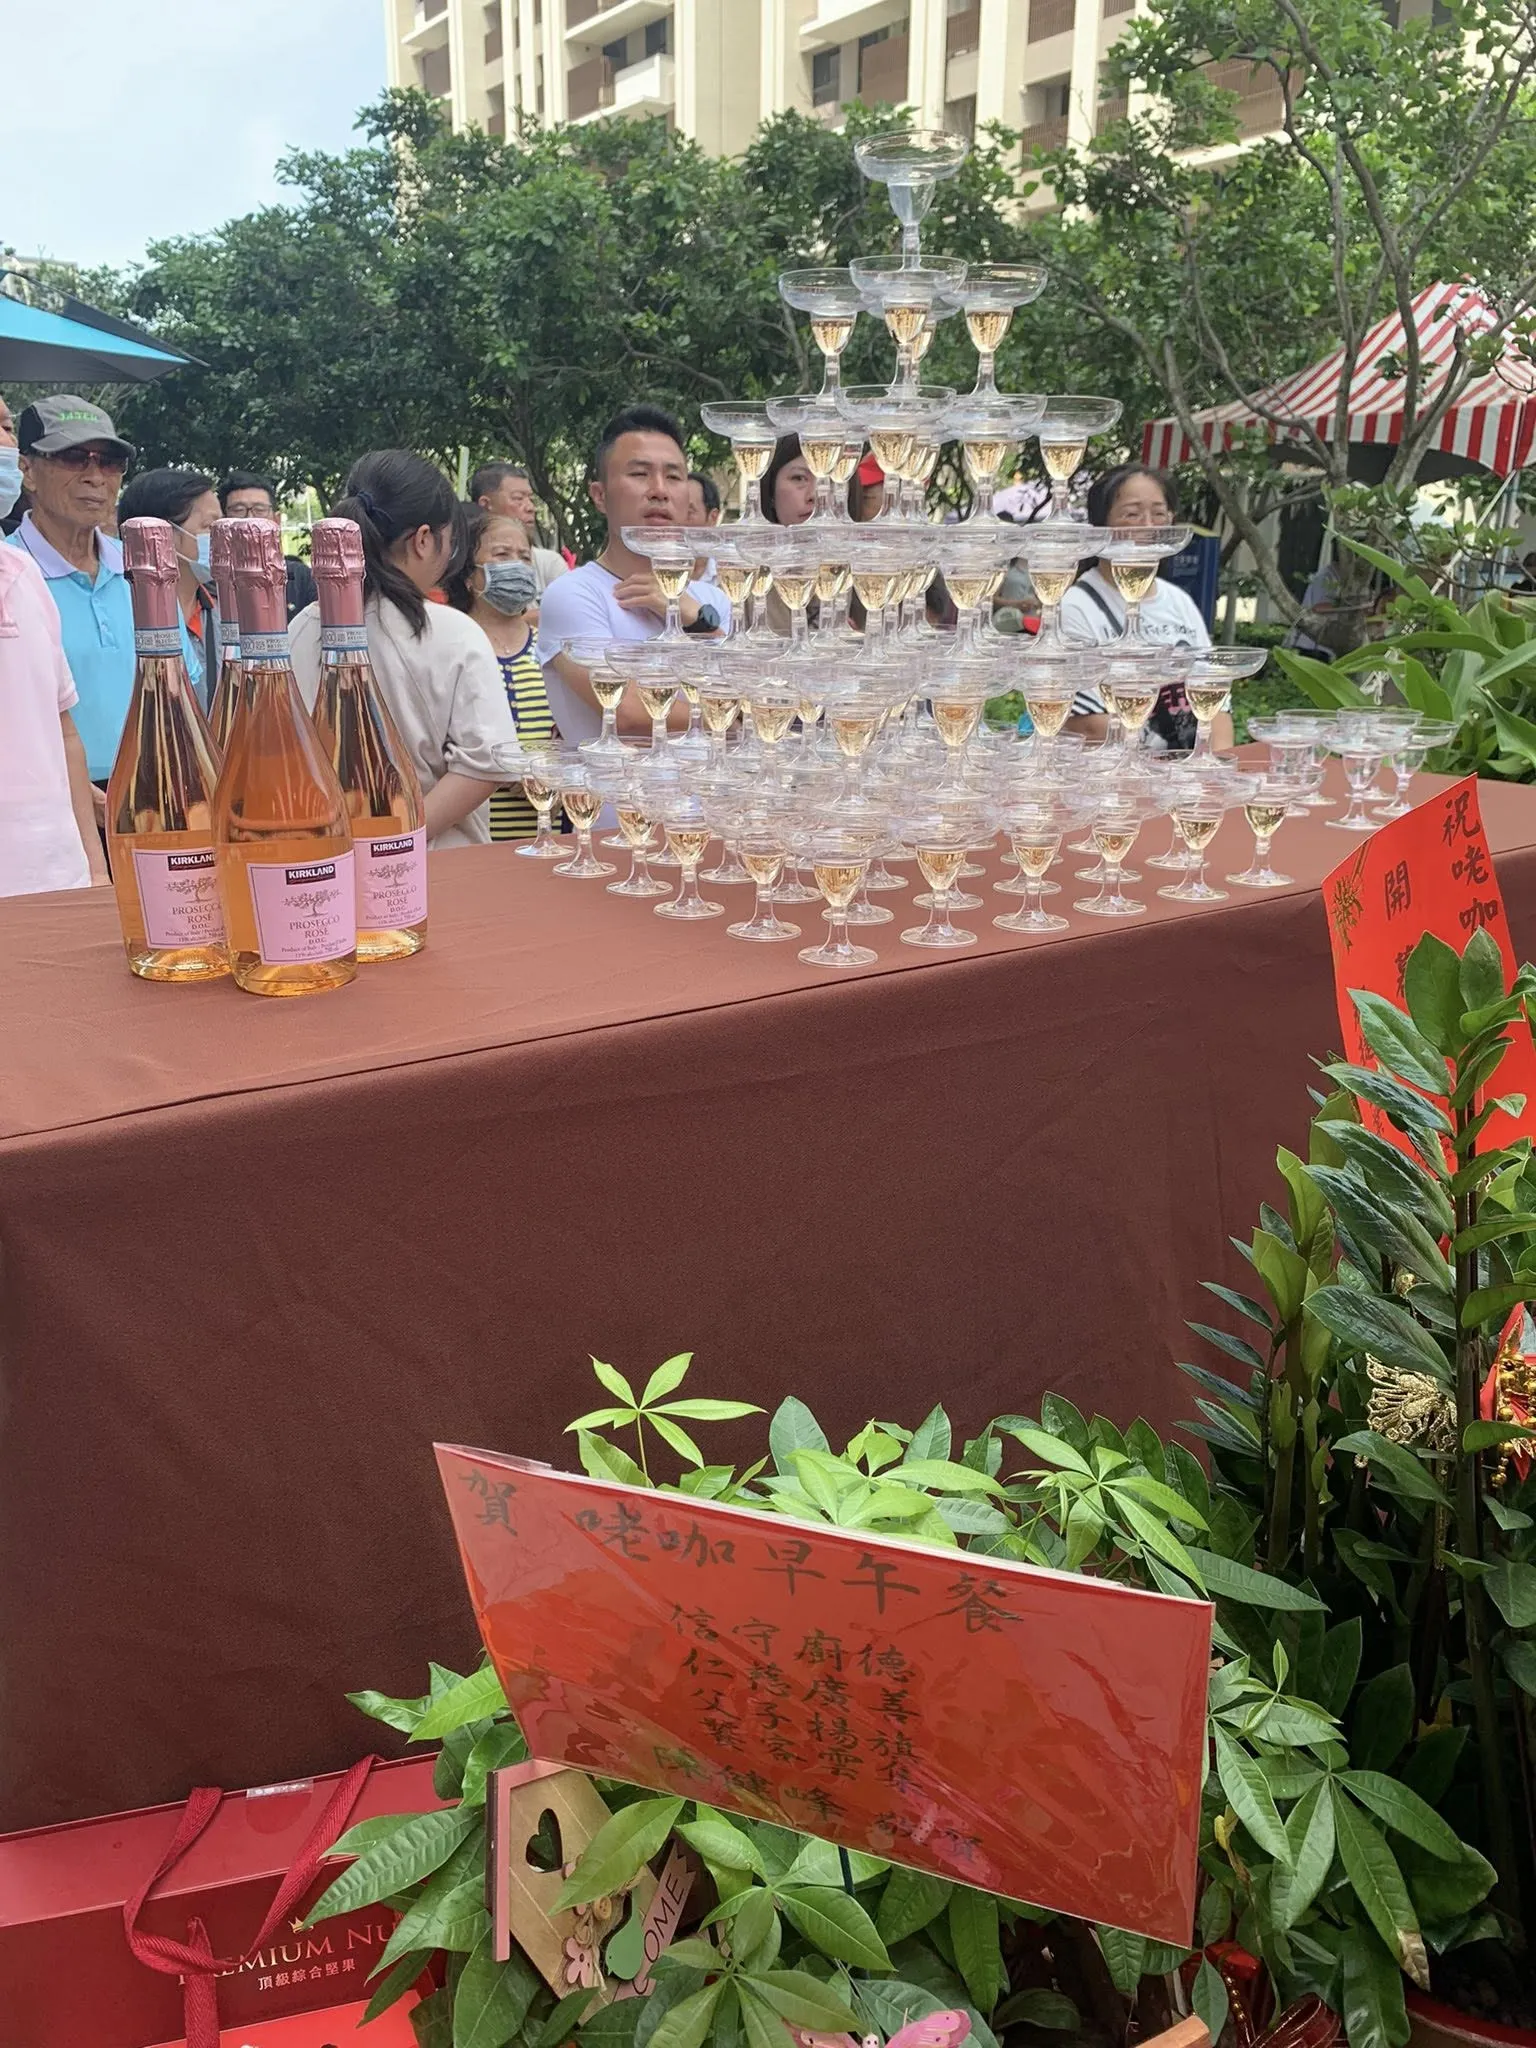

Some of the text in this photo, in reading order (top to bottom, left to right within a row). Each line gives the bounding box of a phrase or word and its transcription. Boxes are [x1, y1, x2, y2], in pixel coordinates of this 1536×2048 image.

[373, 839, 413, 853] KIRKLAND
[288, 864, 334, 879] KIRKLAND
[373, 885, 416, 899] PROSECCO
[289, 915, 339, 930] PROSECCO
[458, 1468, 518, 1538] 賀
[257, 1958, 356, 1991] 頂級綜合堅果
